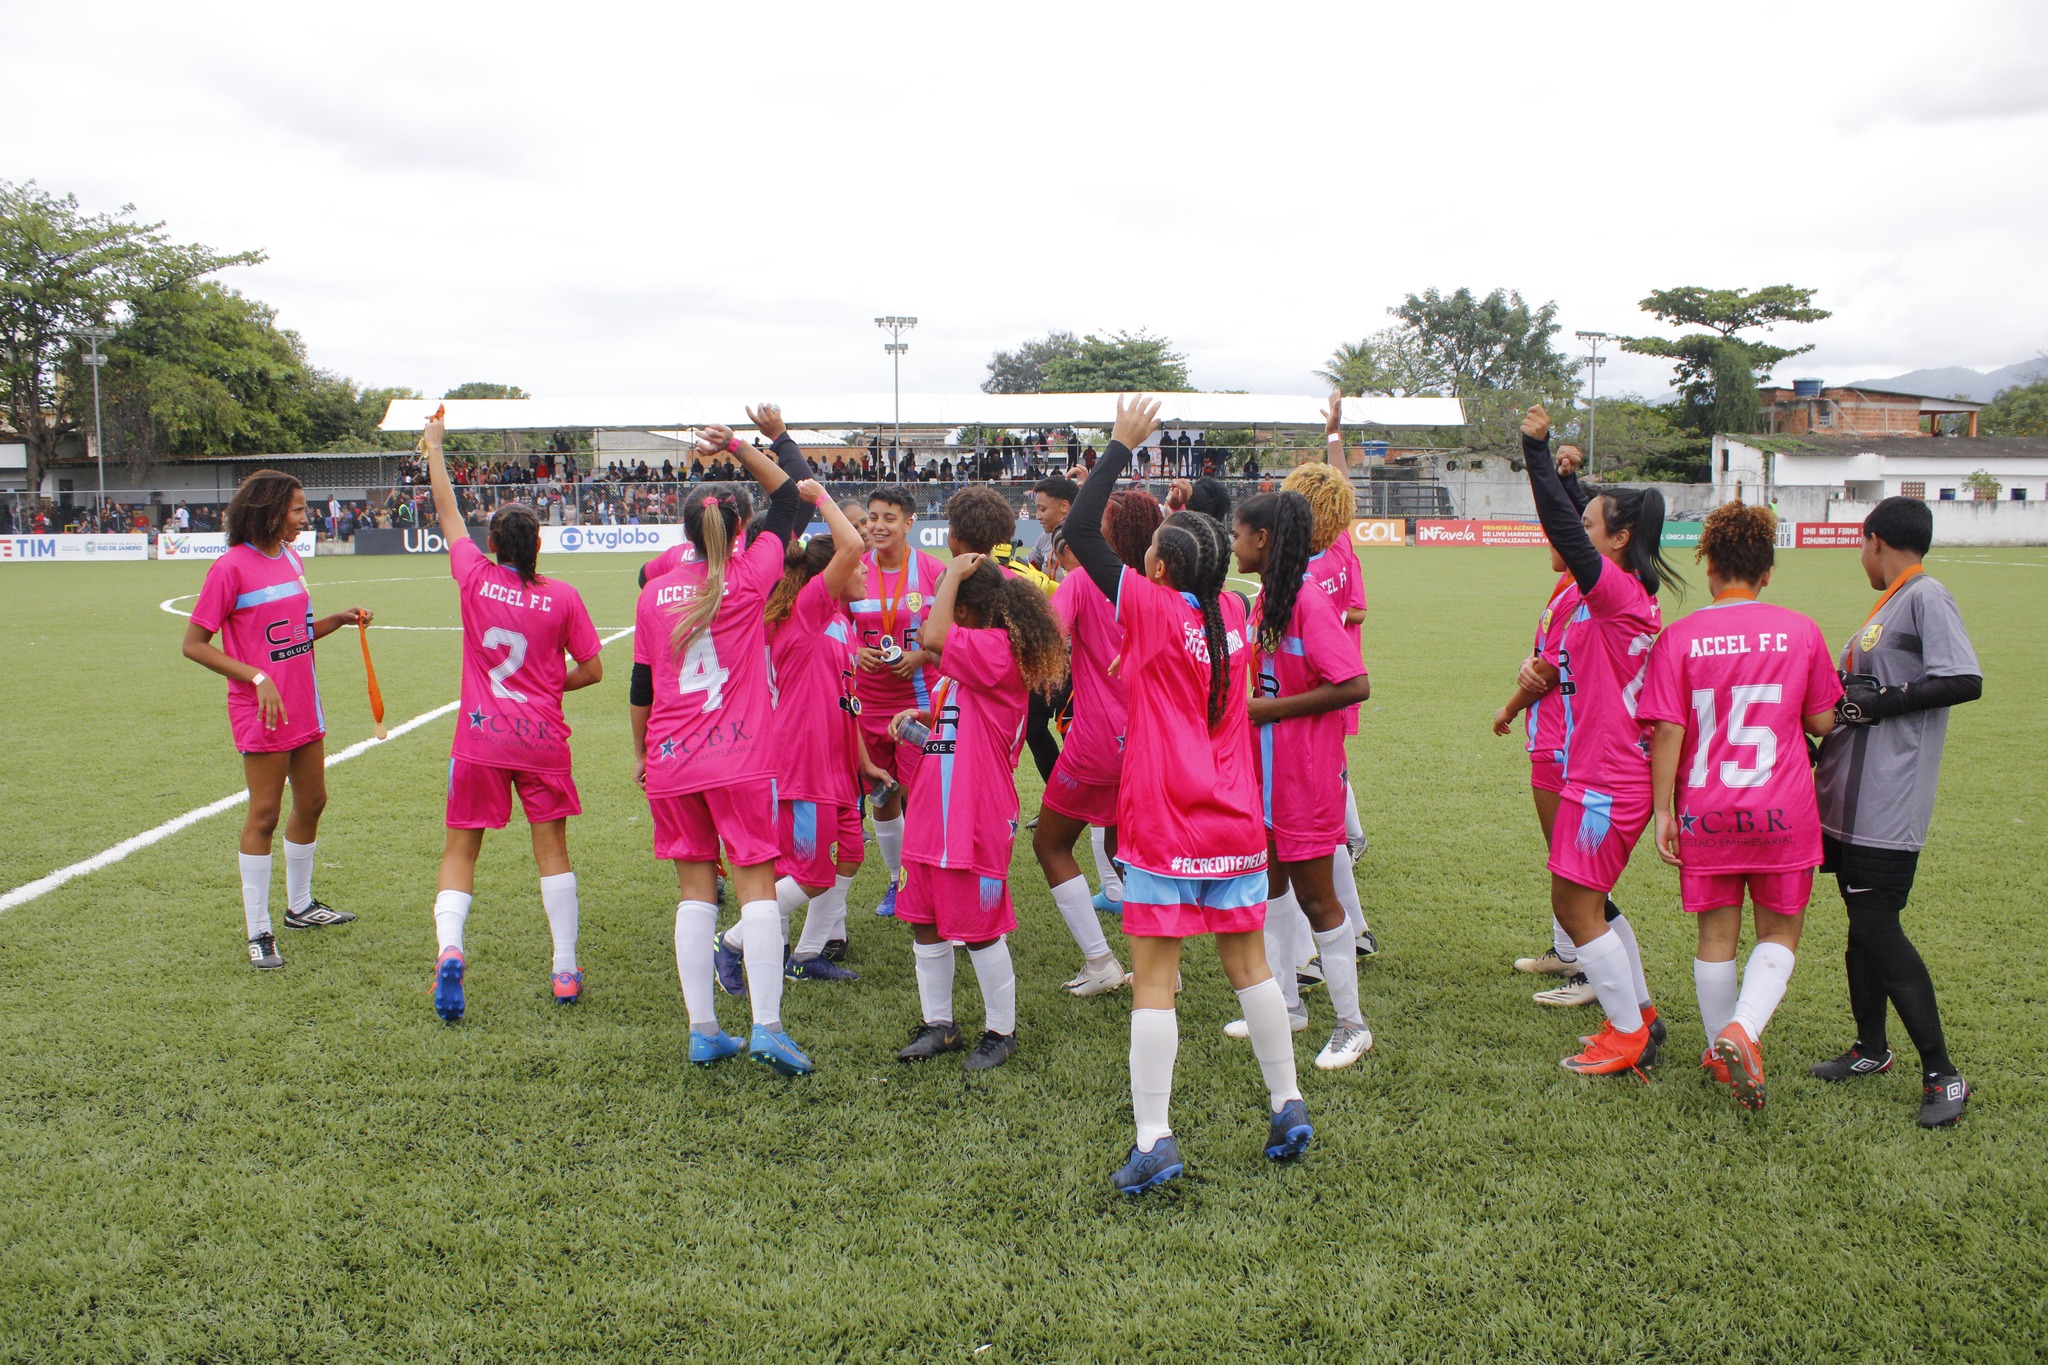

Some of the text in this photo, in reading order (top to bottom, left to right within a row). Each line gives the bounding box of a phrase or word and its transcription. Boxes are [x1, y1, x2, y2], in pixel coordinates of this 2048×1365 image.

[586, 528, 660, 548] tvglobo
[1355, 522, 1402, 542] GOL
[16, 540, 56, 557] TIM
[193, 544, 229, 554] voand
[479, 581, 552, 612] ACCEL F.C
[278, 642, 313, 658] SOLUÇ
[1690, 633, 1788, 658] ACCEL F.C
[482, 626, 528, 704] 2
[678, 626, 730, 714] 4
[490, 714, 556, 741] C.B.R.
[1688, 684, 1782, 788] 15
[1701, 808, 1792, 834] C.B.R.
[1680, 836, 1794, 848] GESTÃO EMPRESARIAL
